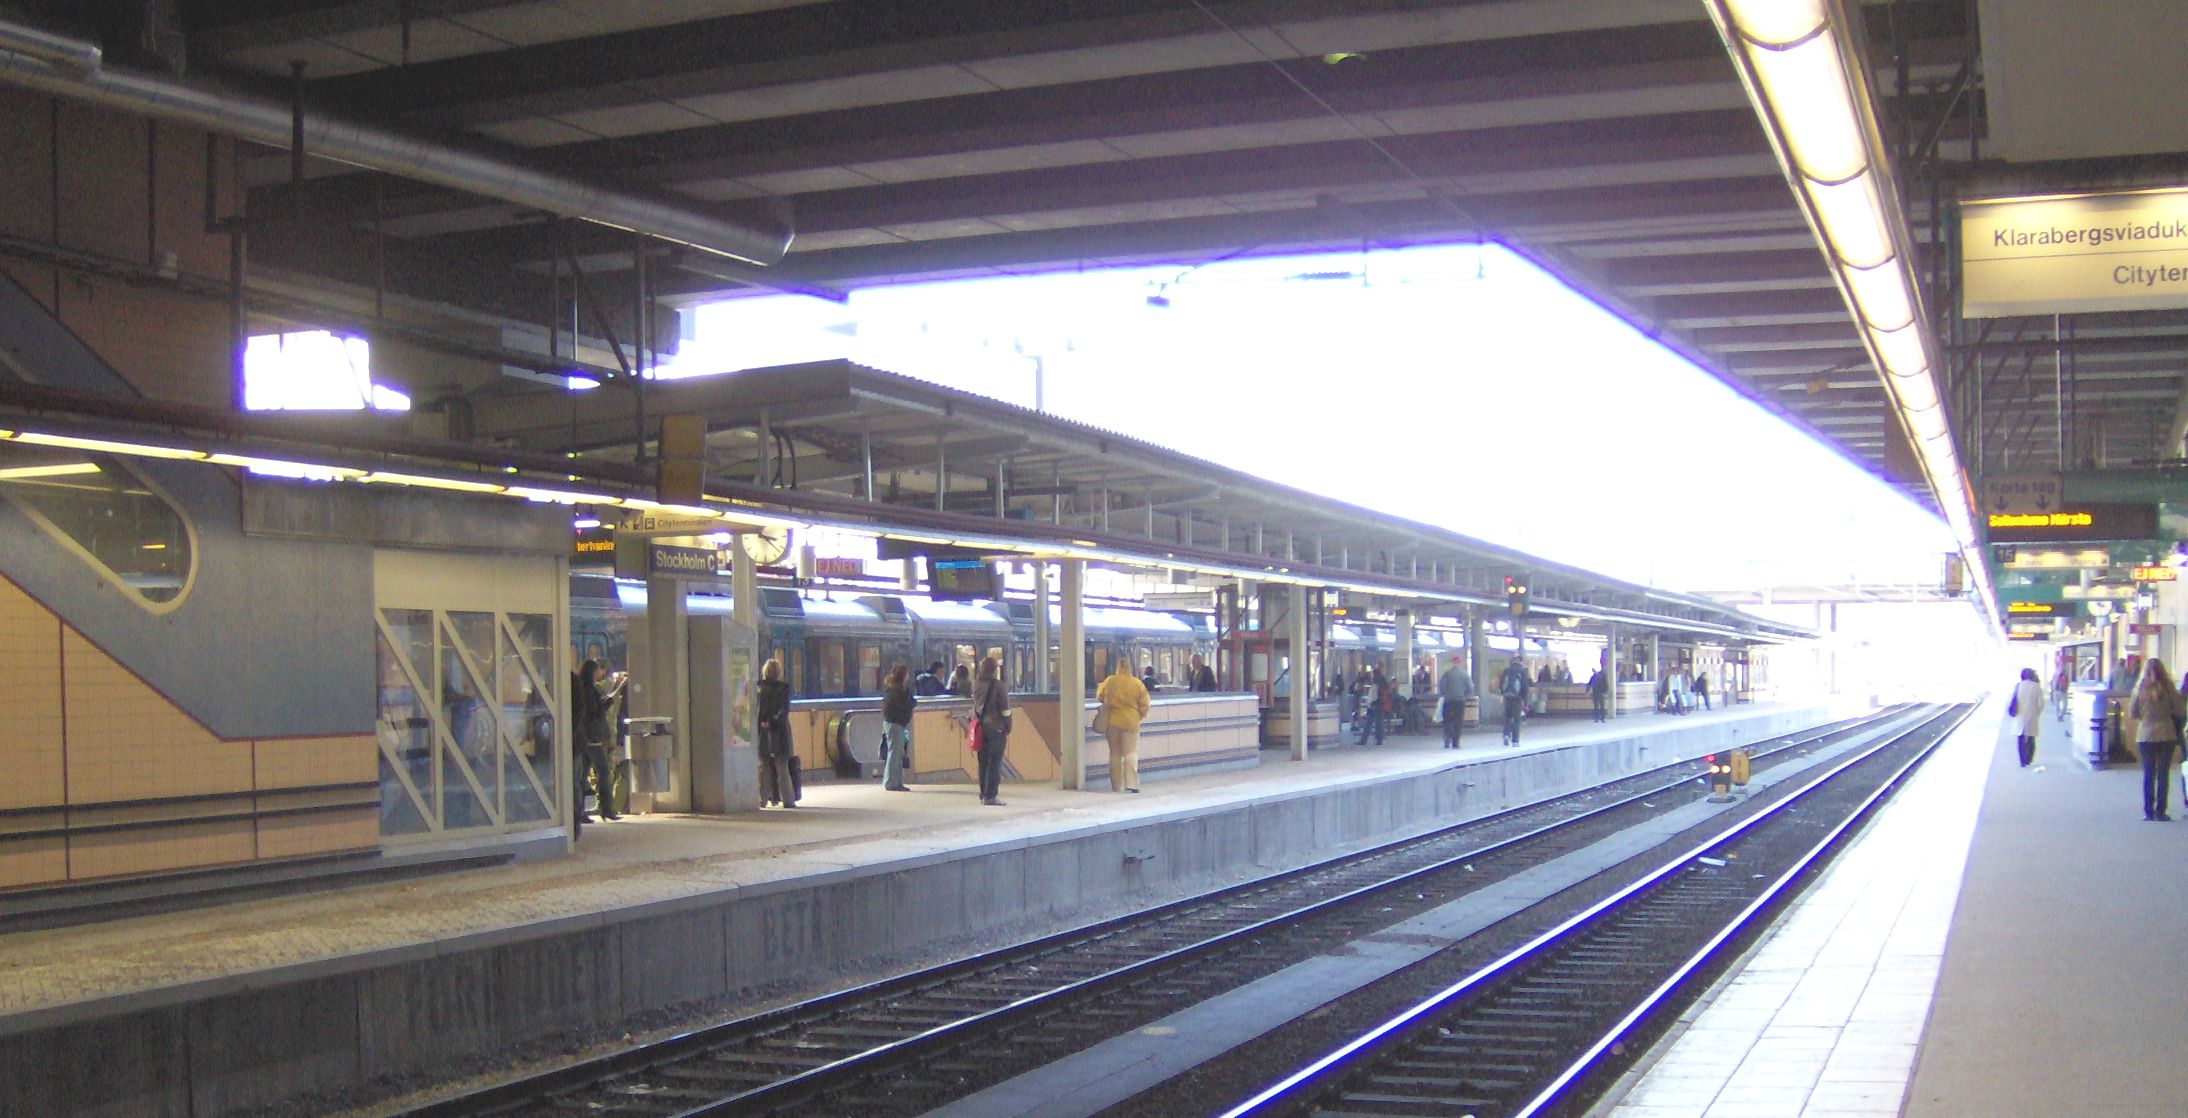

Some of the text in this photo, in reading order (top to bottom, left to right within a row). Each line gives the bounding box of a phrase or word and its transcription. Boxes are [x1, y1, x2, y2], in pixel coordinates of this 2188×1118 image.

[1994, 221, 2188, 247] Klarabergsviaduk
[656, 549, 715, 571] Stockholm C
